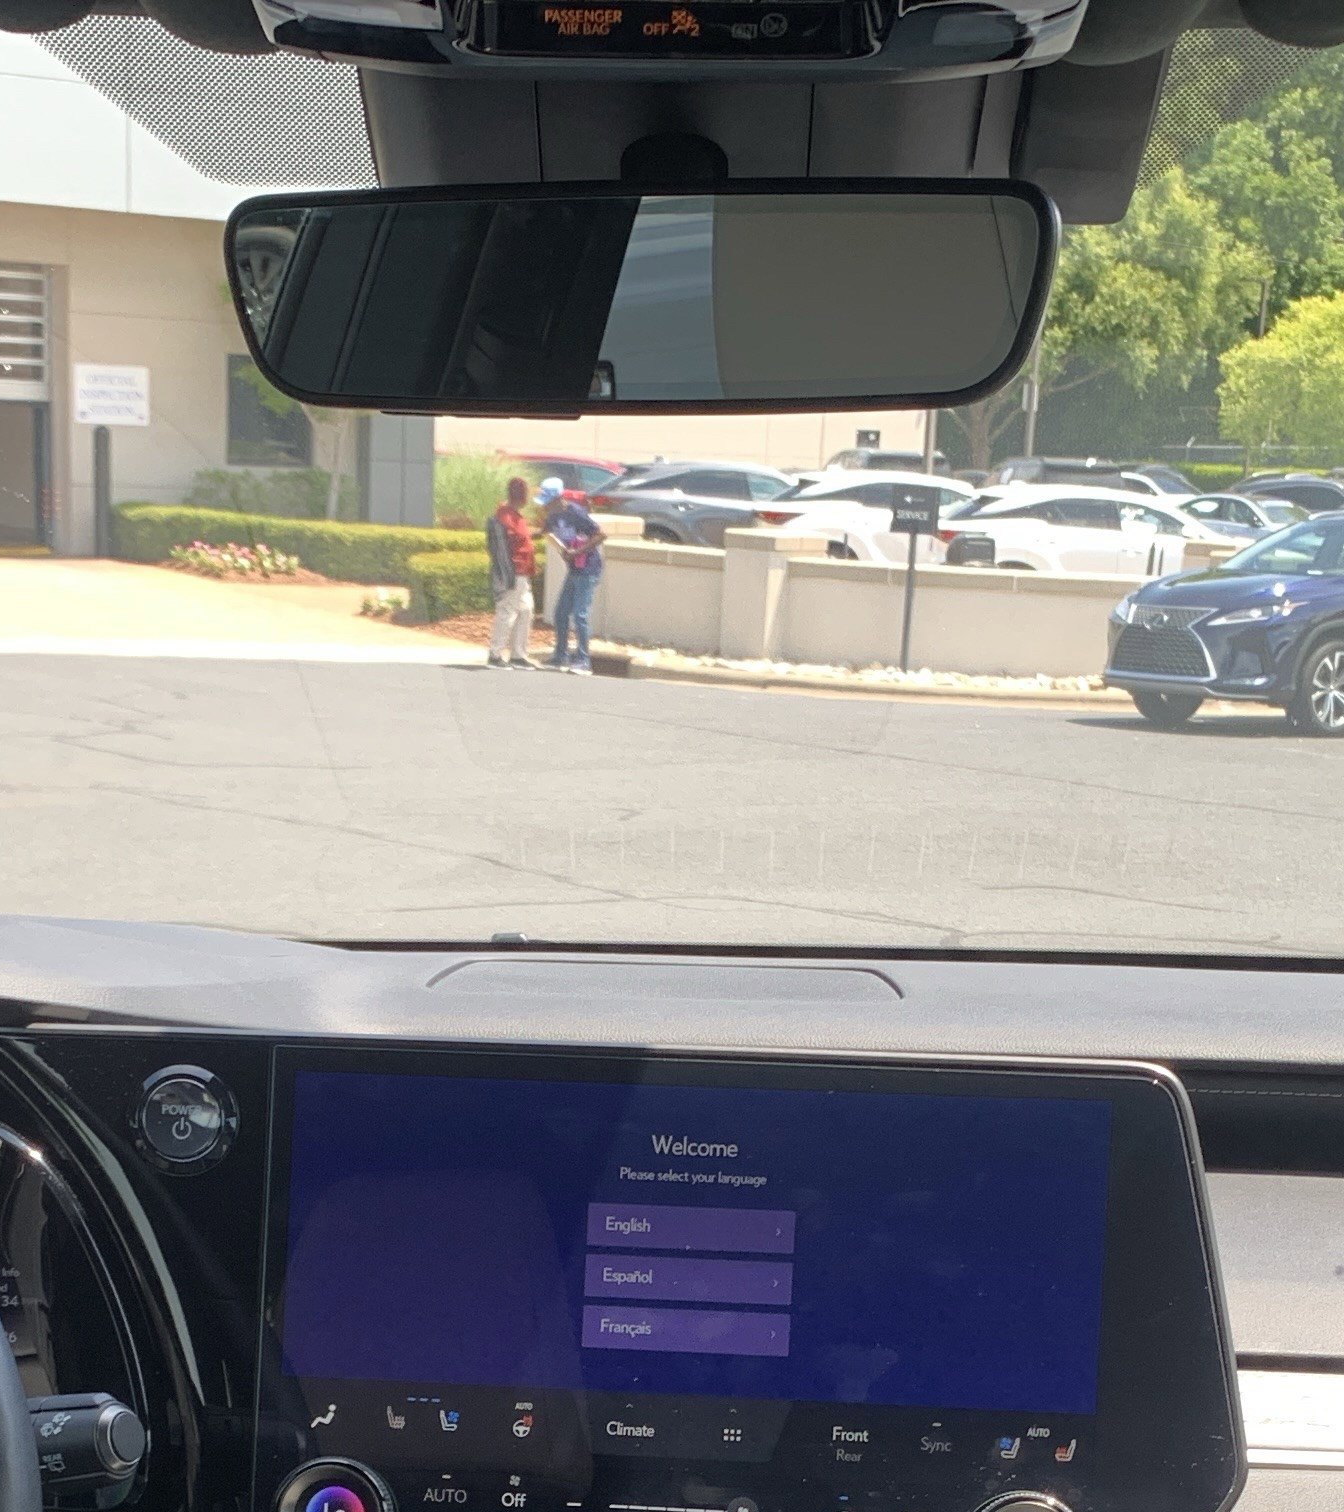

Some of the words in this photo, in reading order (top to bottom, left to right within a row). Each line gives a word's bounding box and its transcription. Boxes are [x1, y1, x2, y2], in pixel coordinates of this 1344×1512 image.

[544, 9, 623, 24] PASSENGER
[557, 23, 579, 36] AIR
[582, 24, 611, 36] BAG
[642, 23, 669, 36] OFF
[652, 1134, 739, 1158] Welcome
[619, 1166, 655, 1181] Please
[657, 1169, 689, 1183] select
[691, 1173, 716, 1188] your
[718, 1171, 768, 1188] language
[605, 1216, 652, 1235] English
[602, 1267, 653, 1286] Español
[1, 1294, 19, 1307] 34
[600, 1318, 652, 1338] Français
[514, 1401, 534, 1411] AUTO
[606, 1419, 656, 1438] Climate
[831, 1425, 869, 1443] Front
[1026, 1426, 1050, 1438] AUTO
[920, 1436, 953, 1453] Sync
[835, 1448, 863, 1463] Rear
[423, 1488, 468, 1504] AUTO
[500, 1492, 527, 1508] Off
